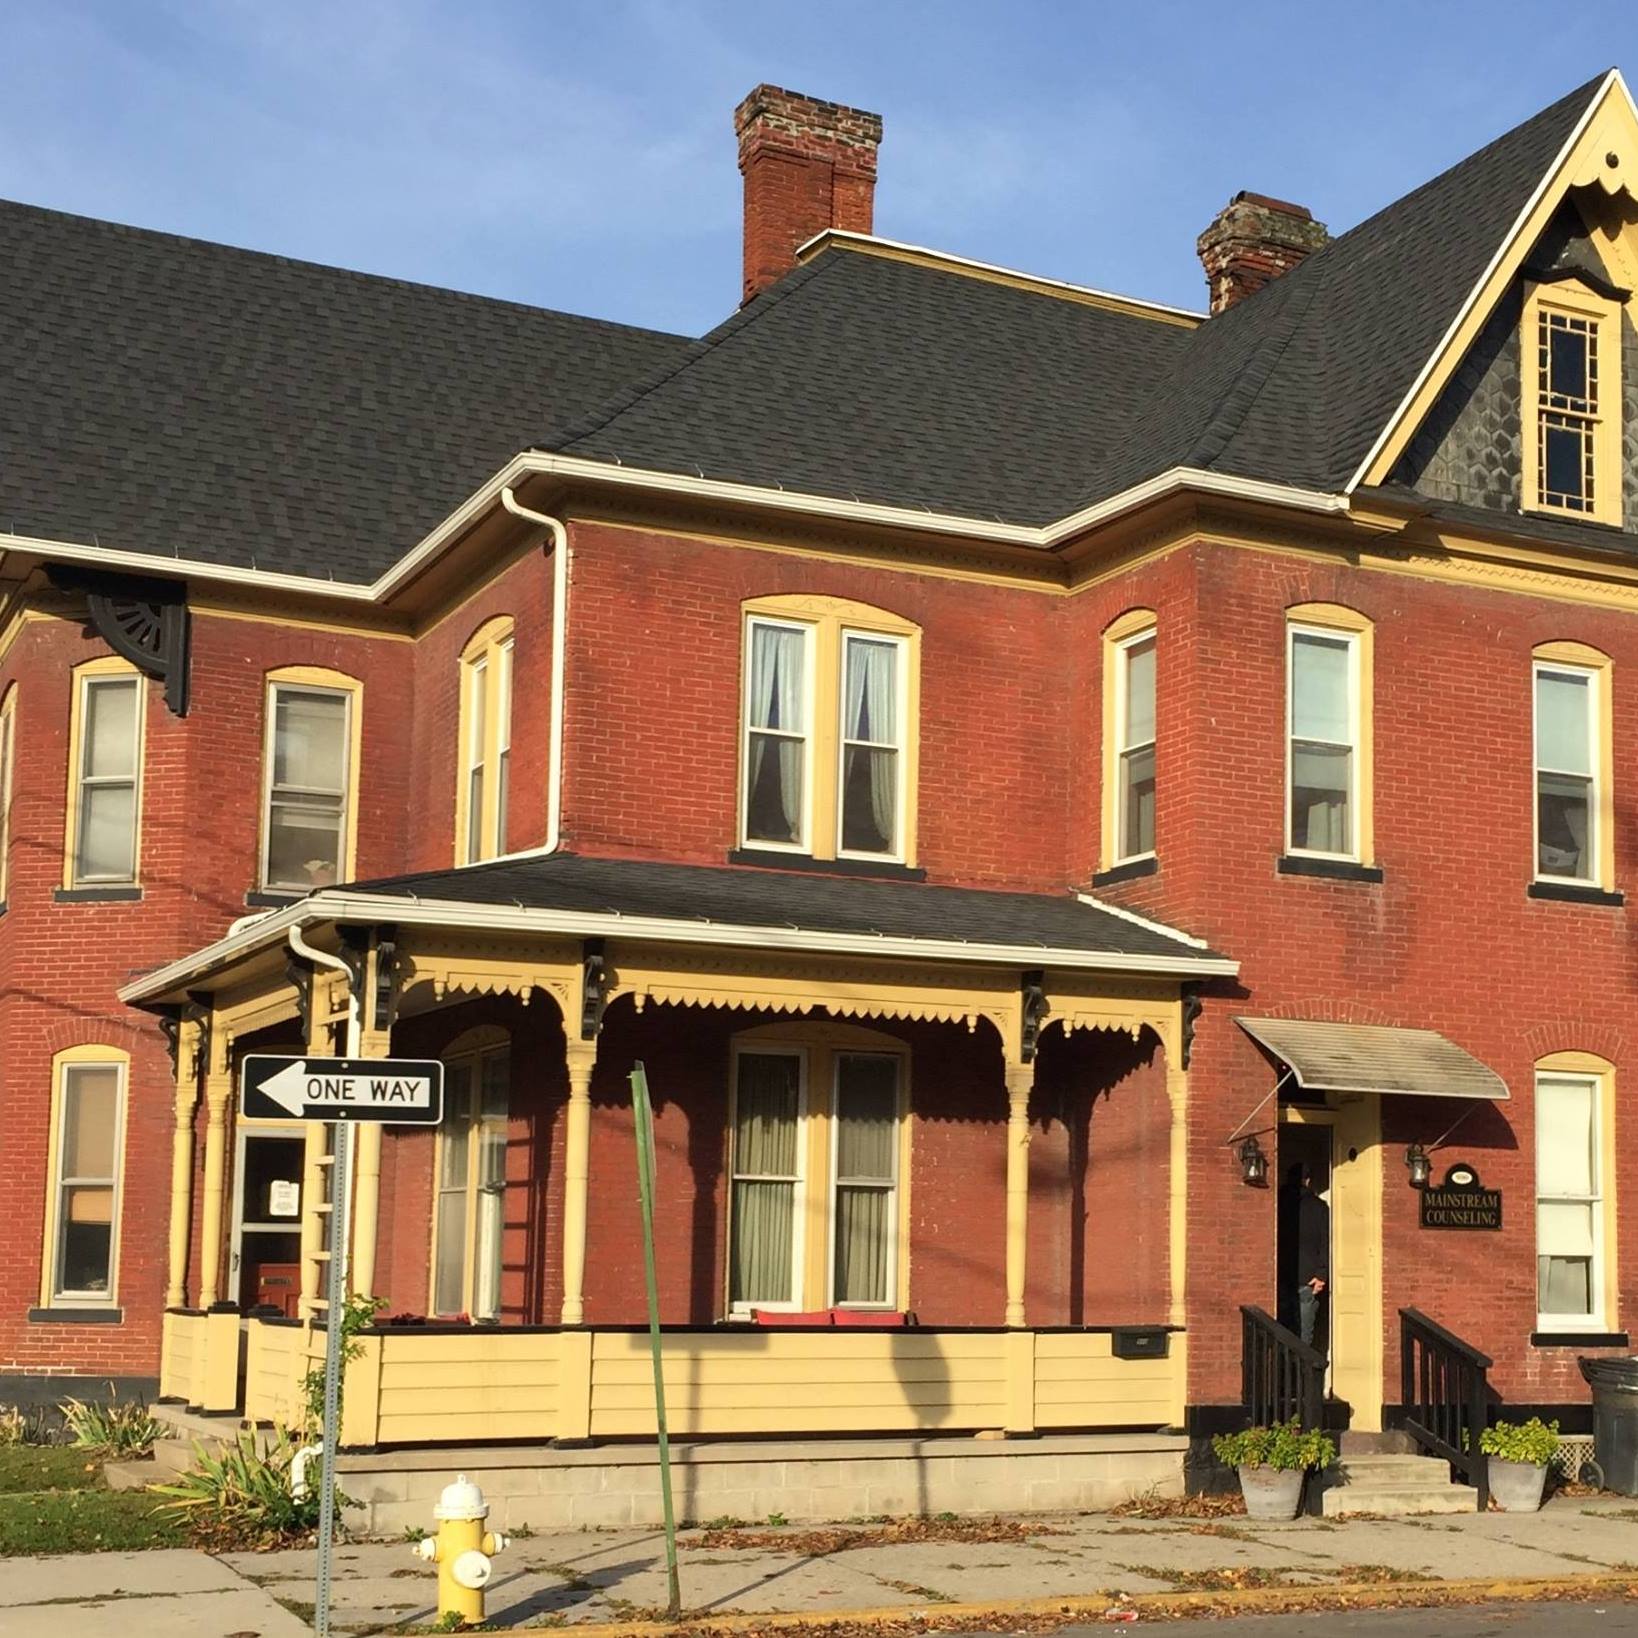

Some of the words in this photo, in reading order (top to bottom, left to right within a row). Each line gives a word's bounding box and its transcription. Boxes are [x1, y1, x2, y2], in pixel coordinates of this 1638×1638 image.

[307, 1078, 356, 1100] ONE
[371, 1080, 421, 1102] WAY
[1425, 1193, 1498, 1208] MAINSTREAM
[1426, 1210, 1496, 1225] COUNSELING
